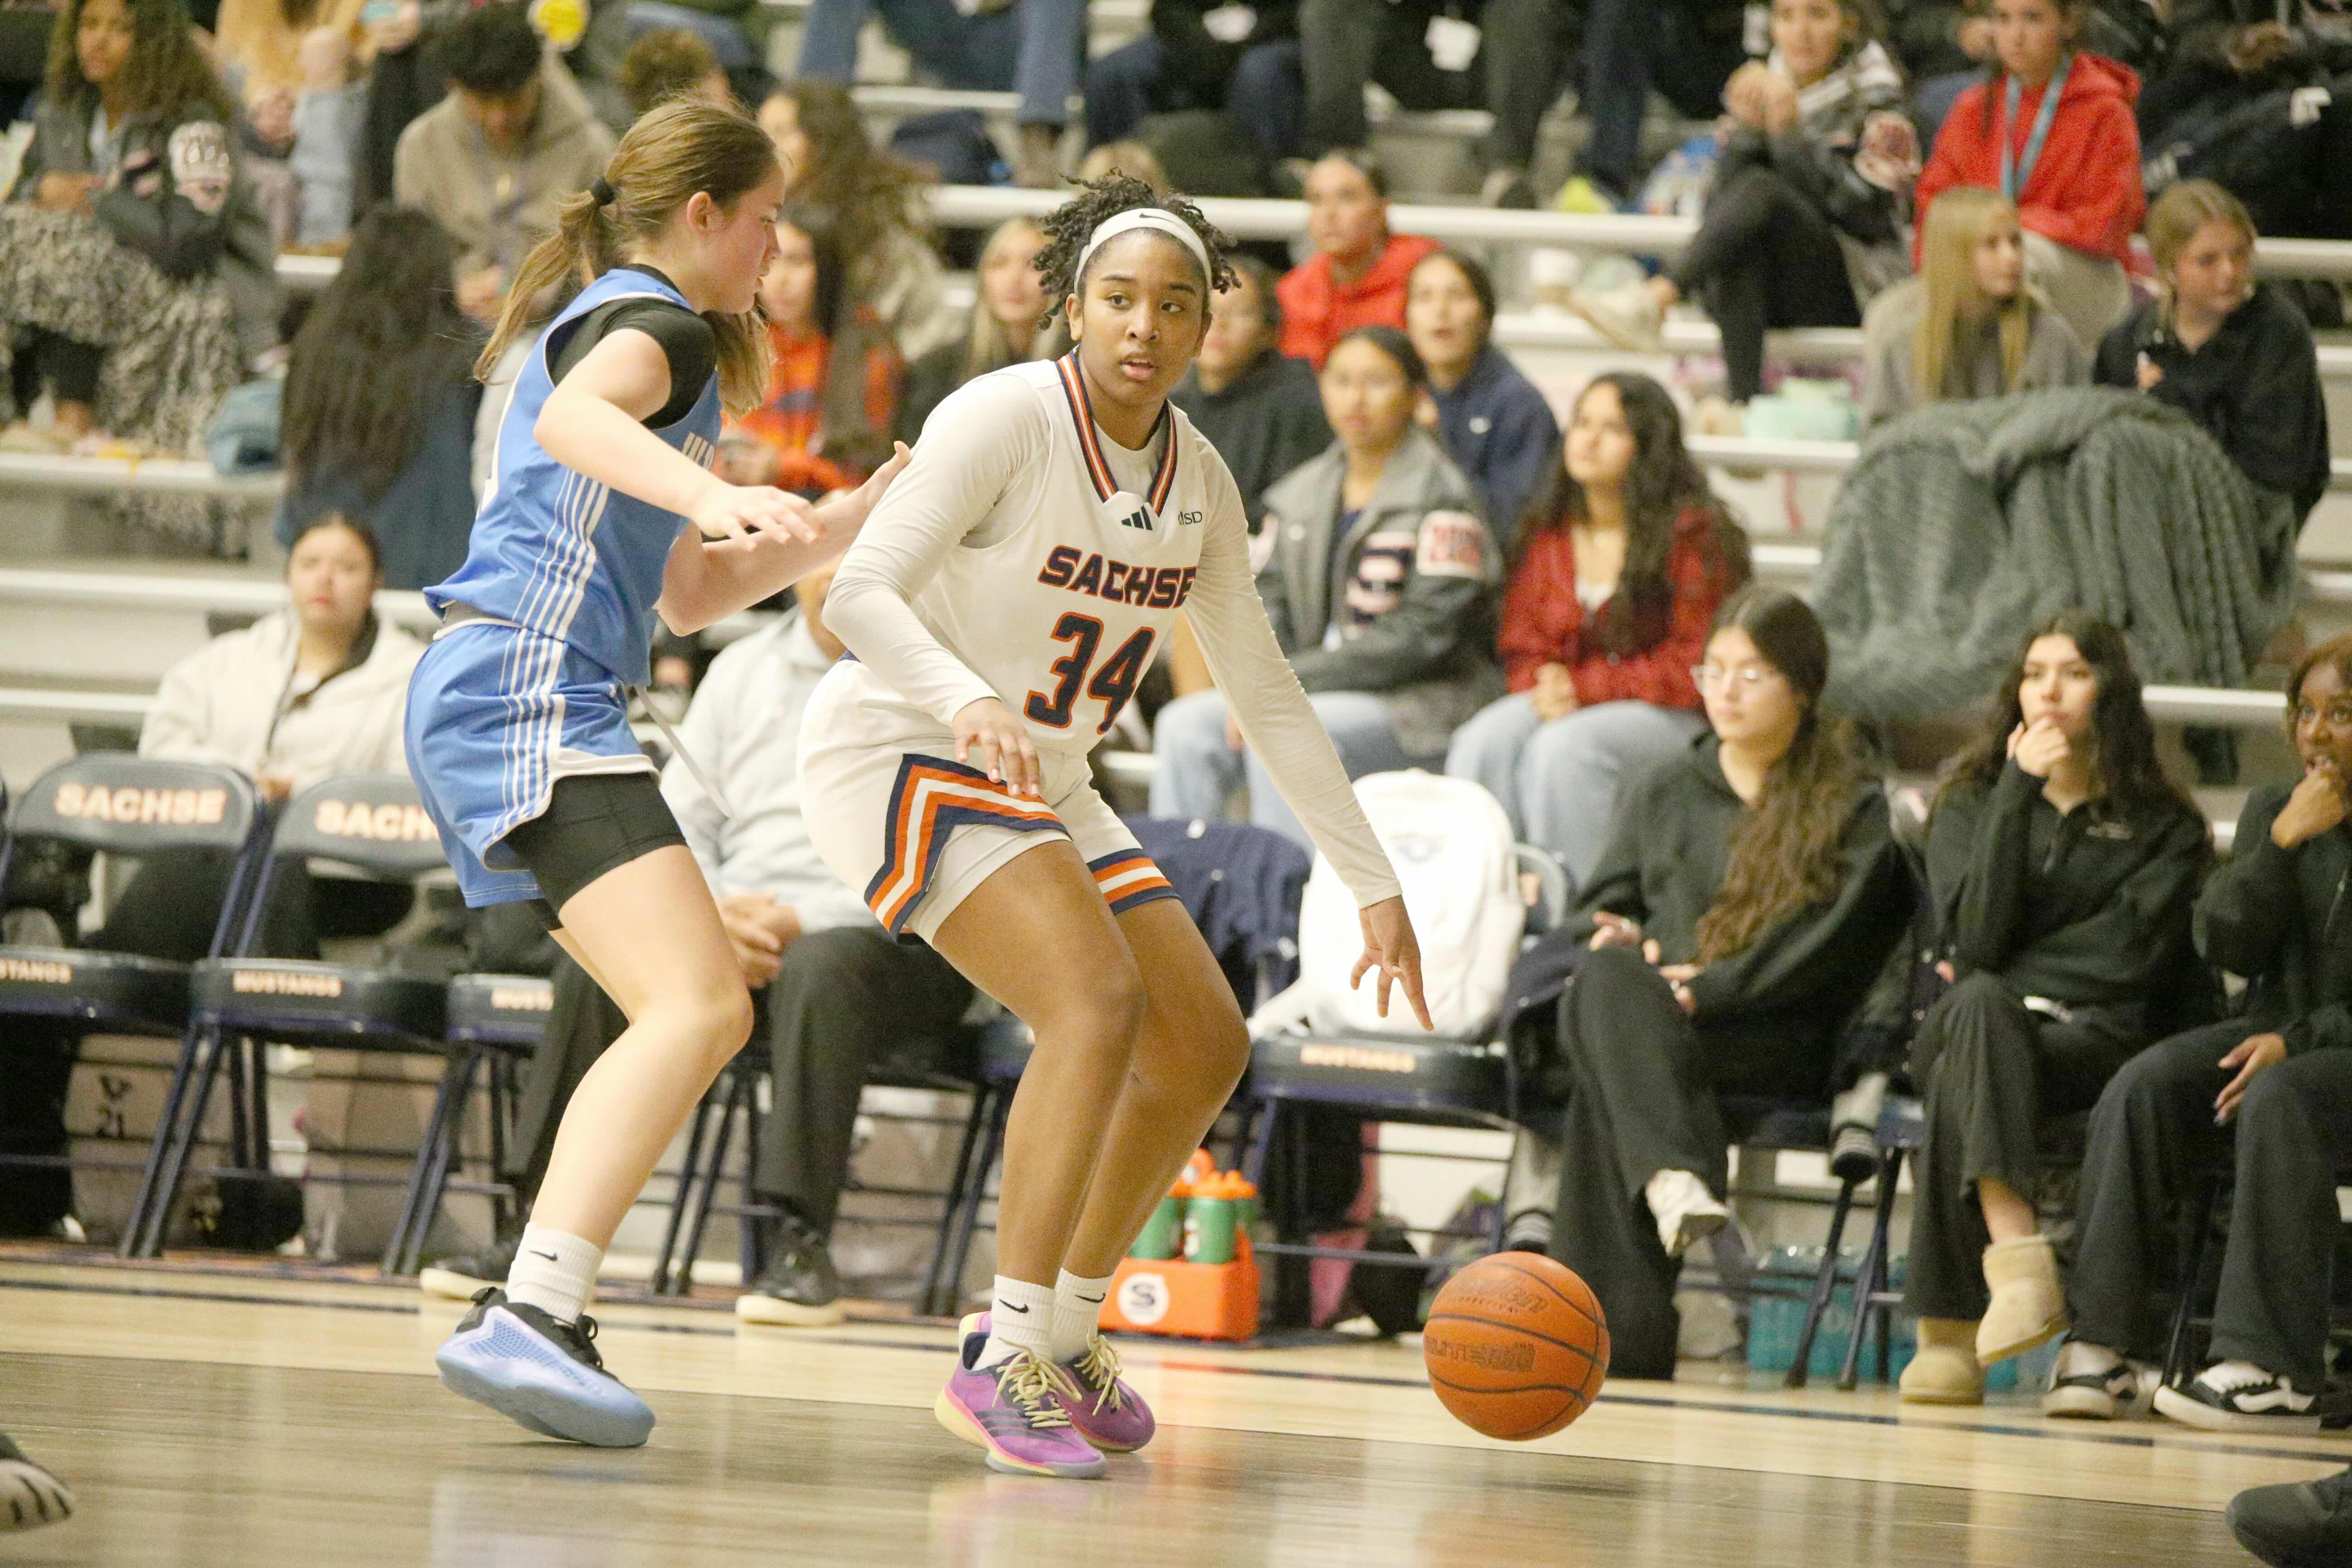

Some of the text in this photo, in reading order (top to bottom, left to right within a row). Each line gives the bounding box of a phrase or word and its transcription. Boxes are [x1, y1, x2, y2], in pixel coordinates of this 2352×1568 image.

[1038, 544, 1197, 609] SACHSE
[1024, 611, 1156, 735] 34
[54, 781, 227, 825] SACHSE
[1131, 1282, 1156, 1308] S
